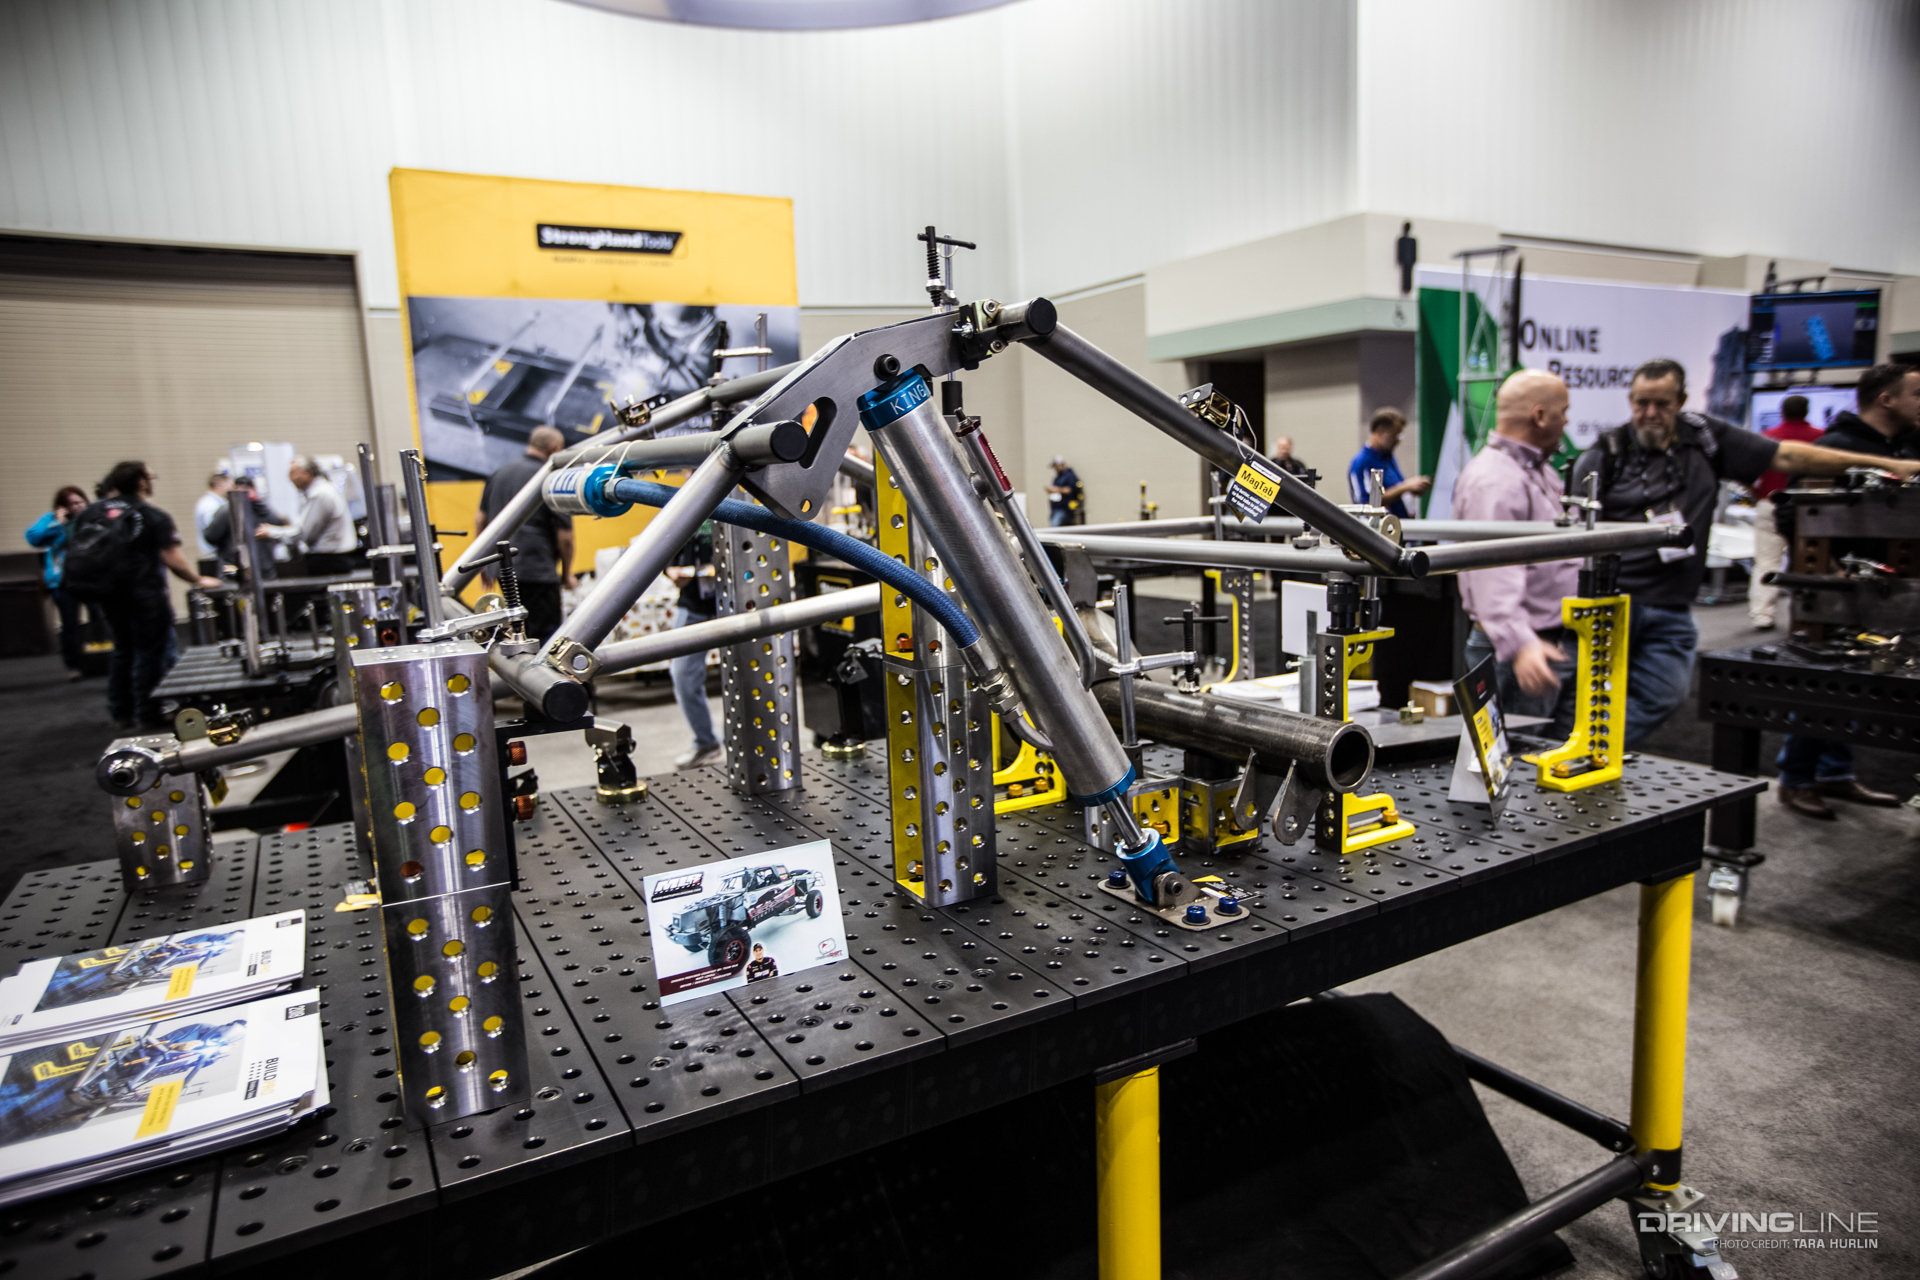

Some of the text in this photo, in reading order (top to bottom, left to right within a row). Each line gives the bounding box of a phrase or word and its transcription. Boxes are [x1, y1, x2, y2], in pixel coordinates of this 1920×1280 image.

[1549, 360, 1636, 388] RESOURC
[890, 384, 927, 415] KING
[1241, 470, 1274, 497] MagTab
